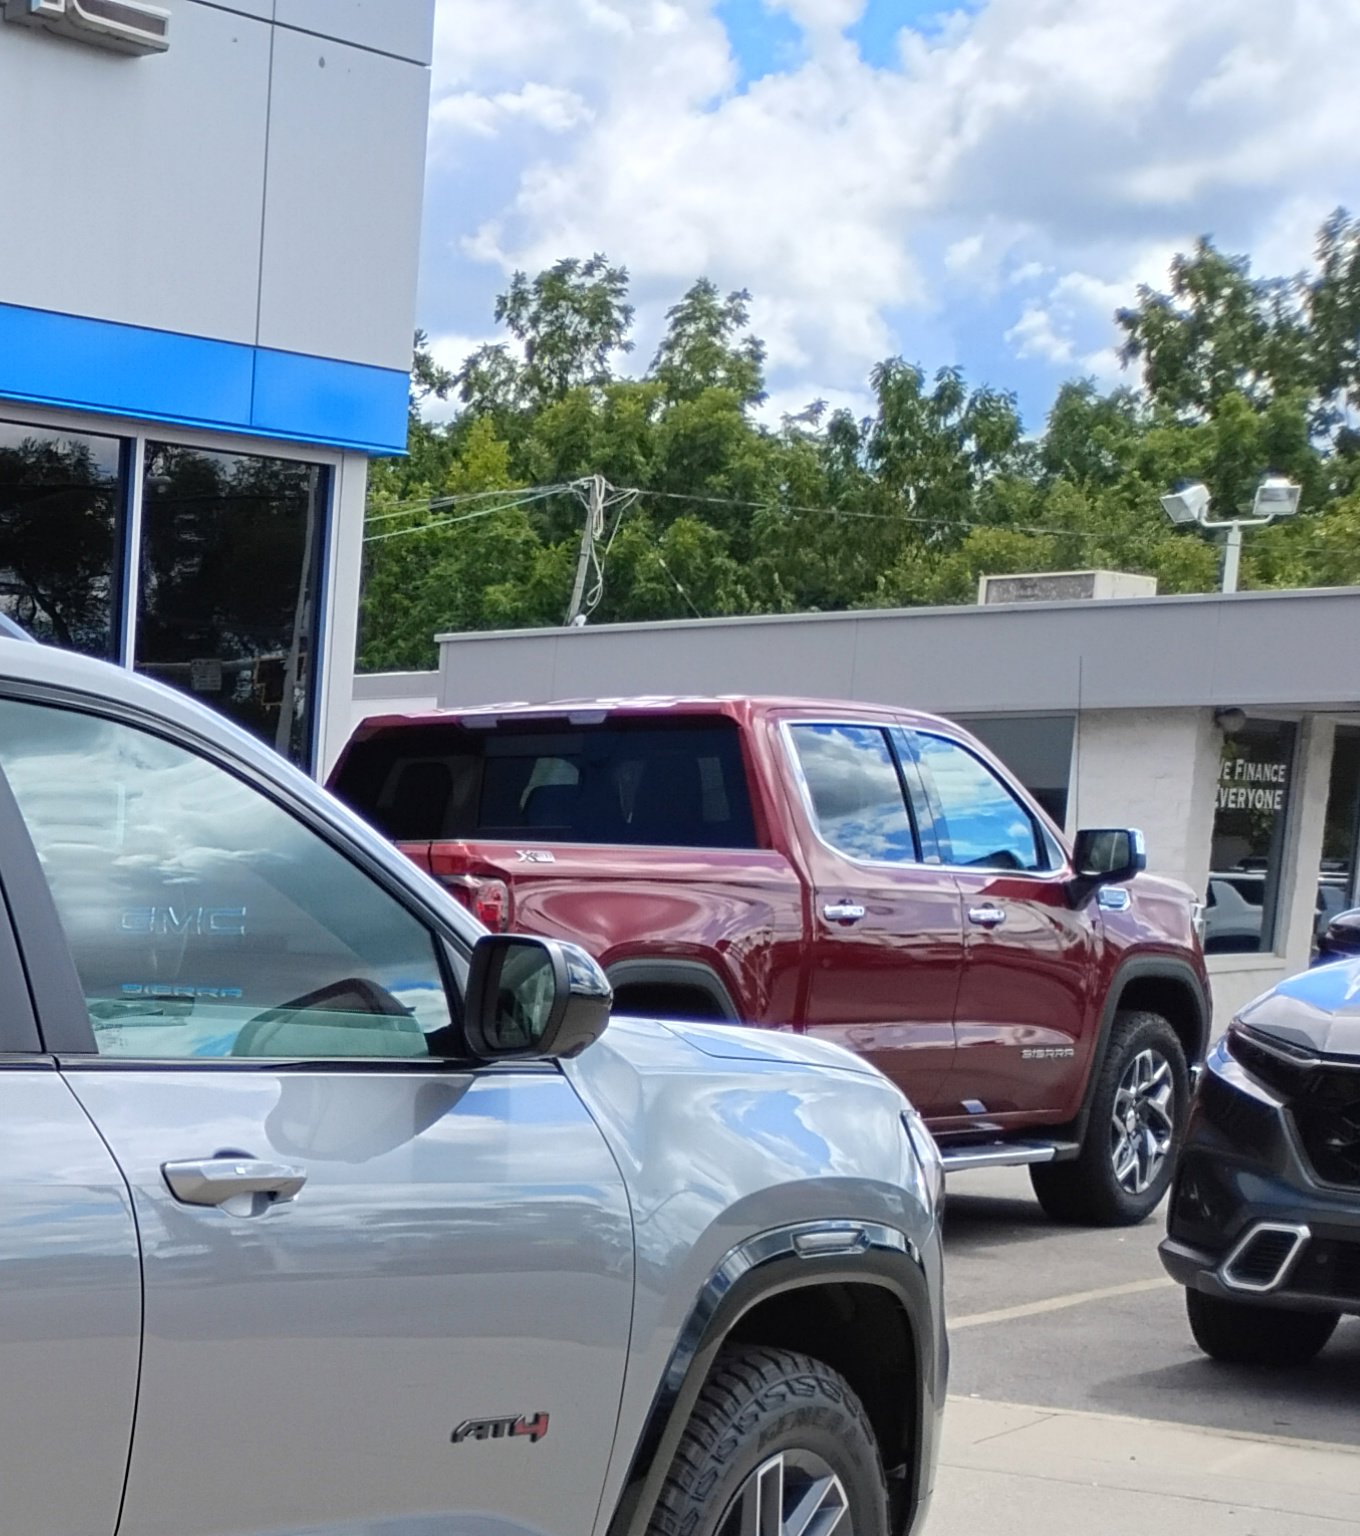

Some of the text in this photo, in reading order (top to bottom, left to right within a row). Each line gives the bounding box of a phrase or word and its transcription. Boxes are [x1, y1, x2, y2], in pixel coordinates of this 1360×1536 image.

[1234, 758, 1287, 783] FINANCE
[120, 906, 247, 936] GMC
[451, 1411, 550, 1444] AT4
